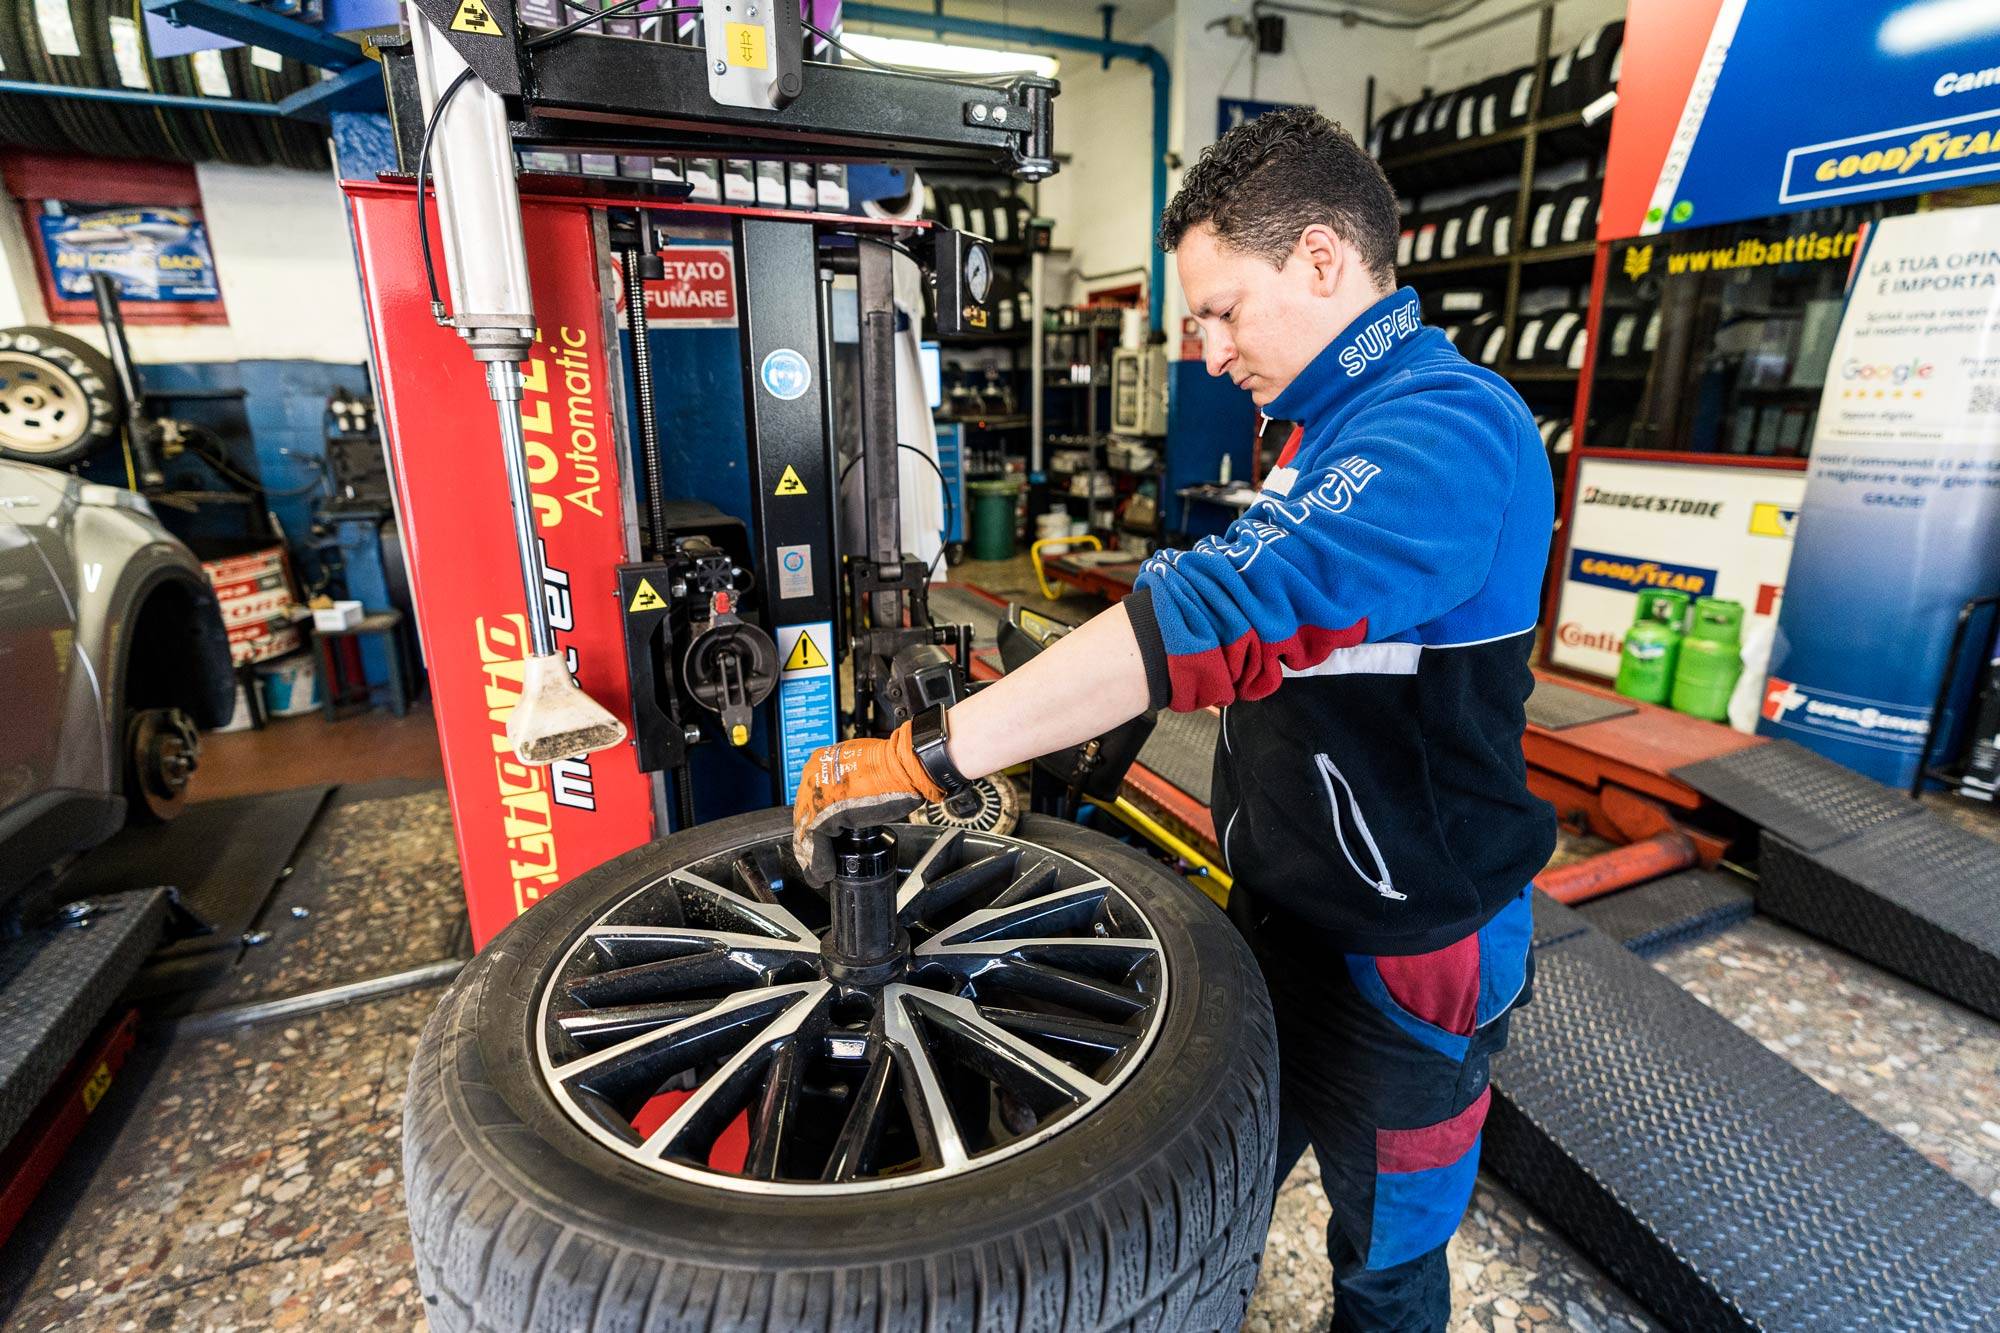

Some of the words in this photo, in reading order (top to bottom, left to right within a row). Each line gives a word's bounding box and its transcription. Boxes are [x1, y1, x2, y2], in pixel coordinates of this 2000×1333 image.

[159, 254, 204, 270] BACK
[664, 261, 725, 280] ETATO
[1899, 255, 1939, 273] TUA
[644, 289, 729, 308] FUMARE
[1842, 356, 1935, 388] Google
[549, 326, 604, 517] Automatic
[1584, 487, 1724, 519] BRIDGESTONE
[1580, 558, 1705, 593] GOODYEAR
